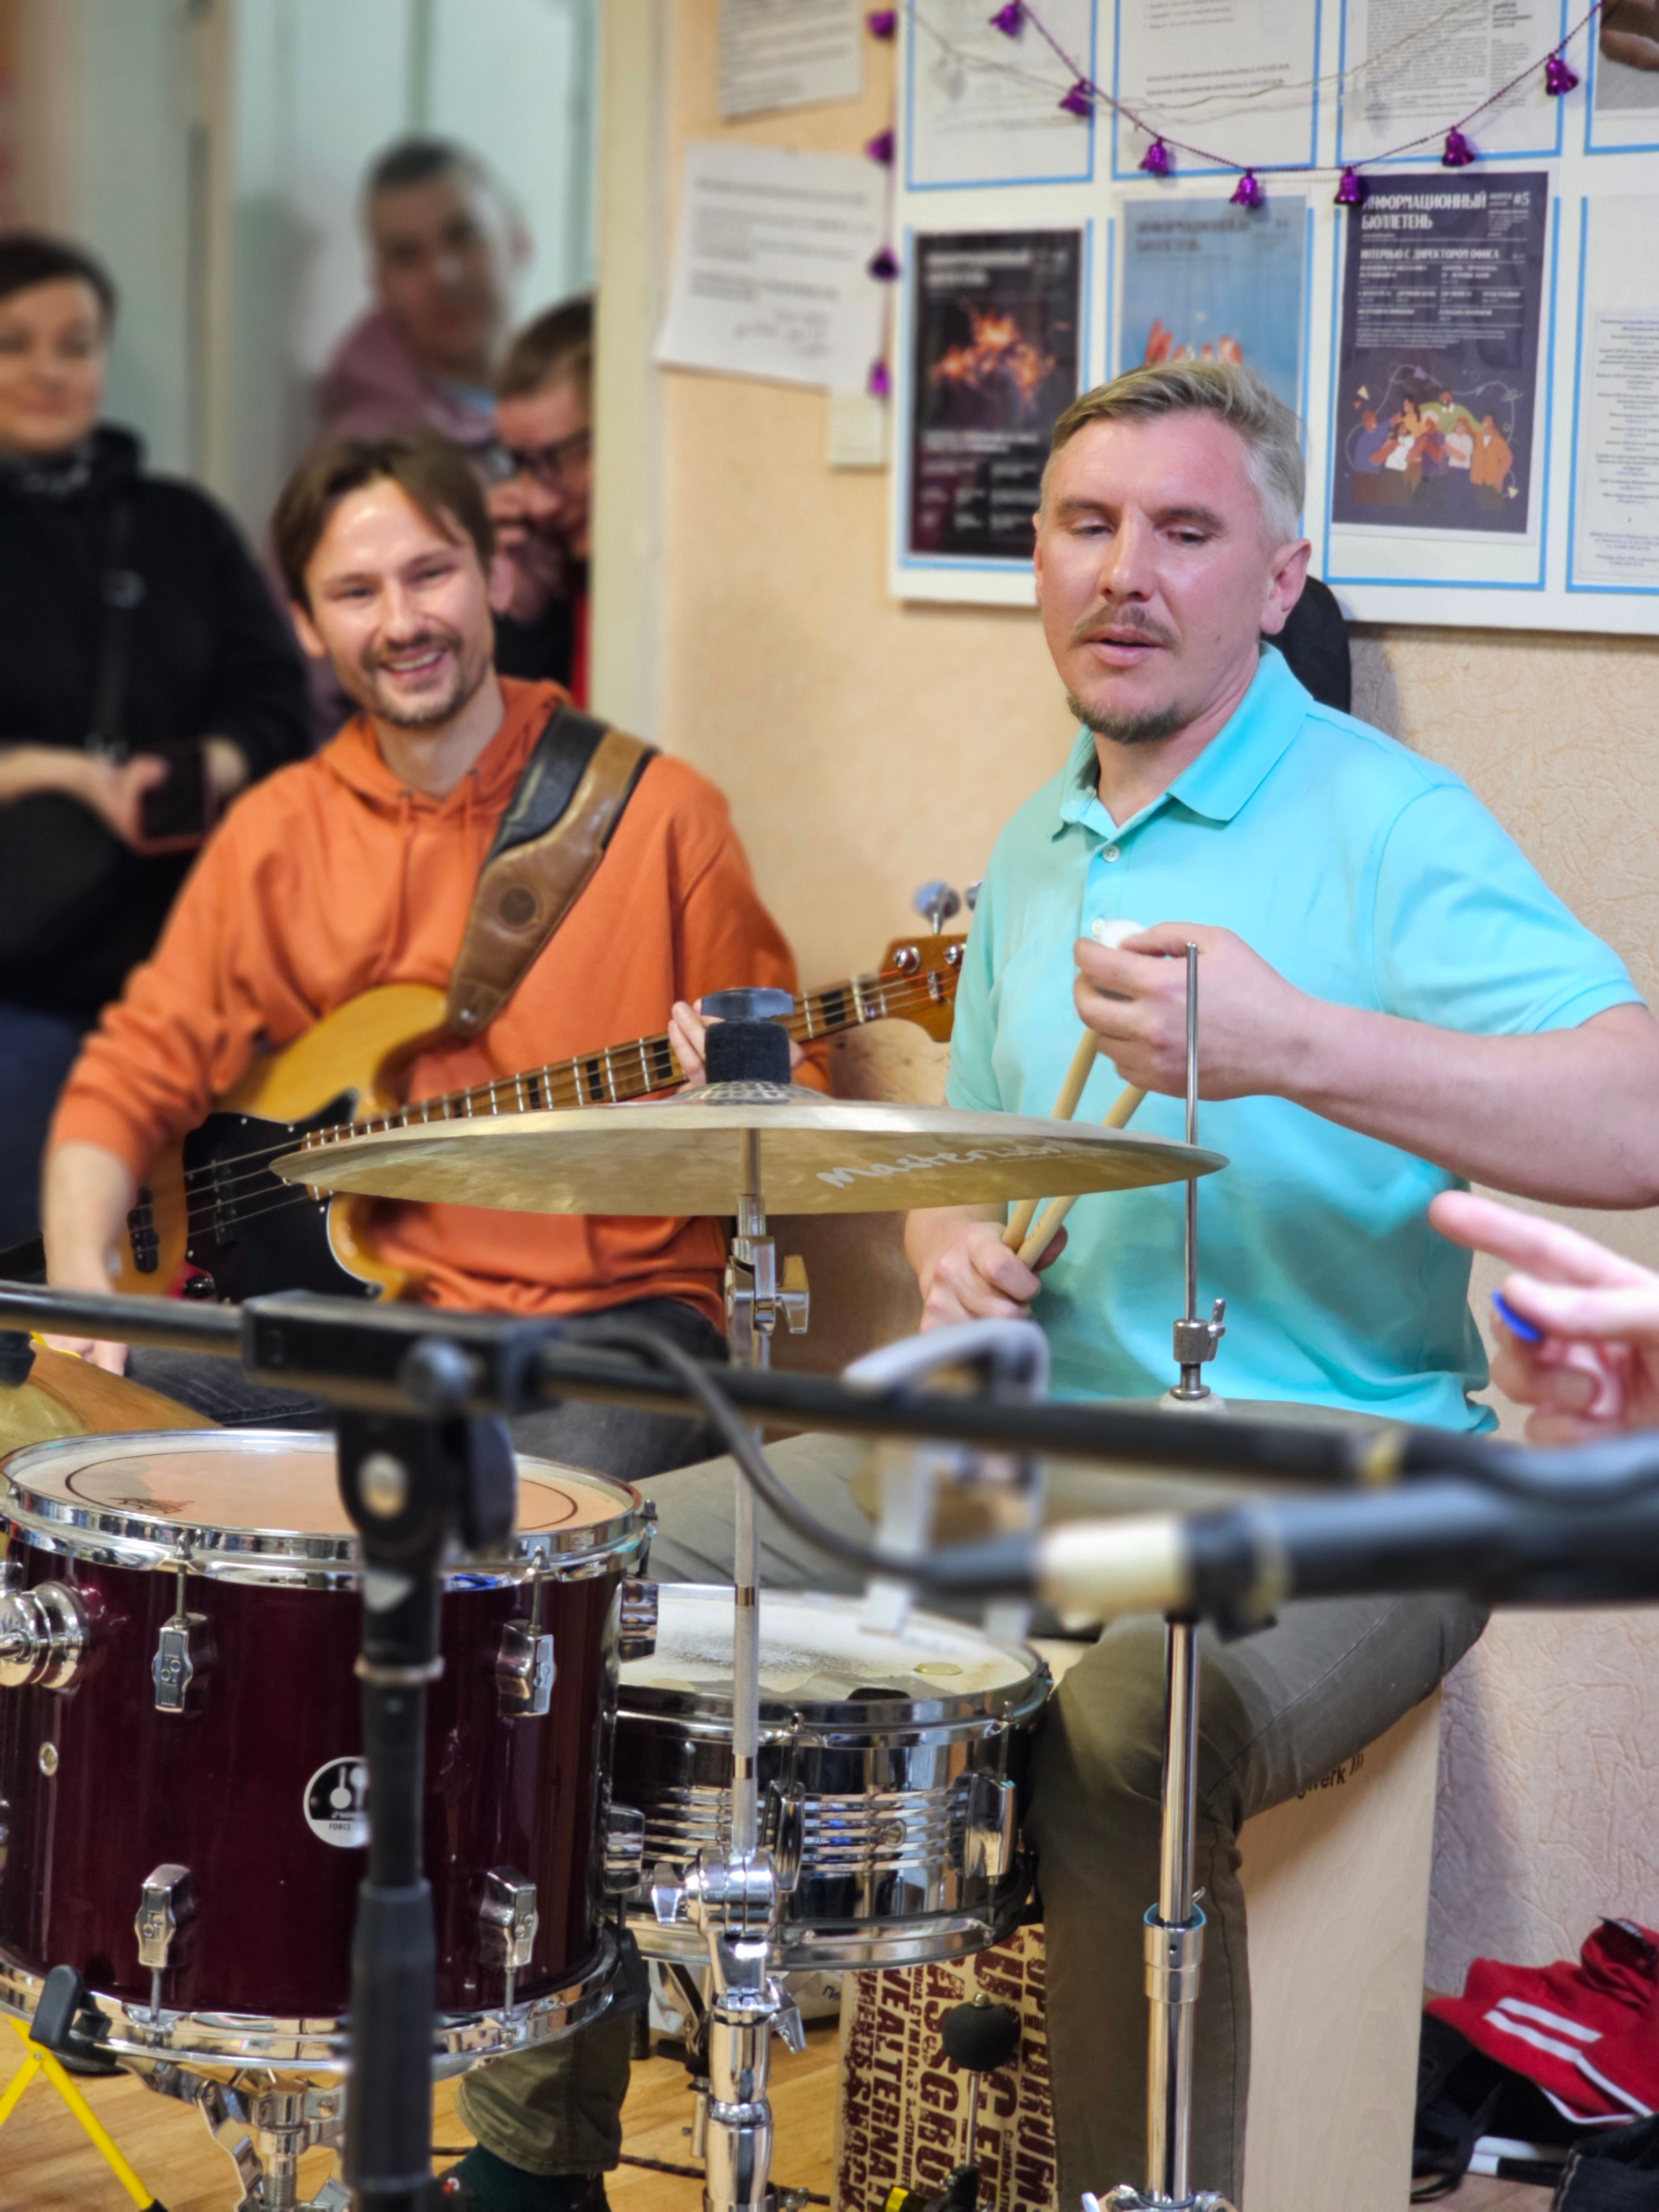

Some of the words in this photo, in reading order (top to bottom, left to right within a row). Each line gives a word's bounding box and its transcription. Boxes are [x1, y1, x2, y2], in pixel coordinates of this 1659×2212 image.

[1363, 191, 1487, 211] ИНФОРМАЦИОННЫЙ
[1514, 192, 1530, 206] #5
[1362, 213, 1433, 230] БЮЛЛЕТЕНЬ
[329, 1822, 351, 1831] FORCE
[1014, 2036, 1056, 2212] DRUM
